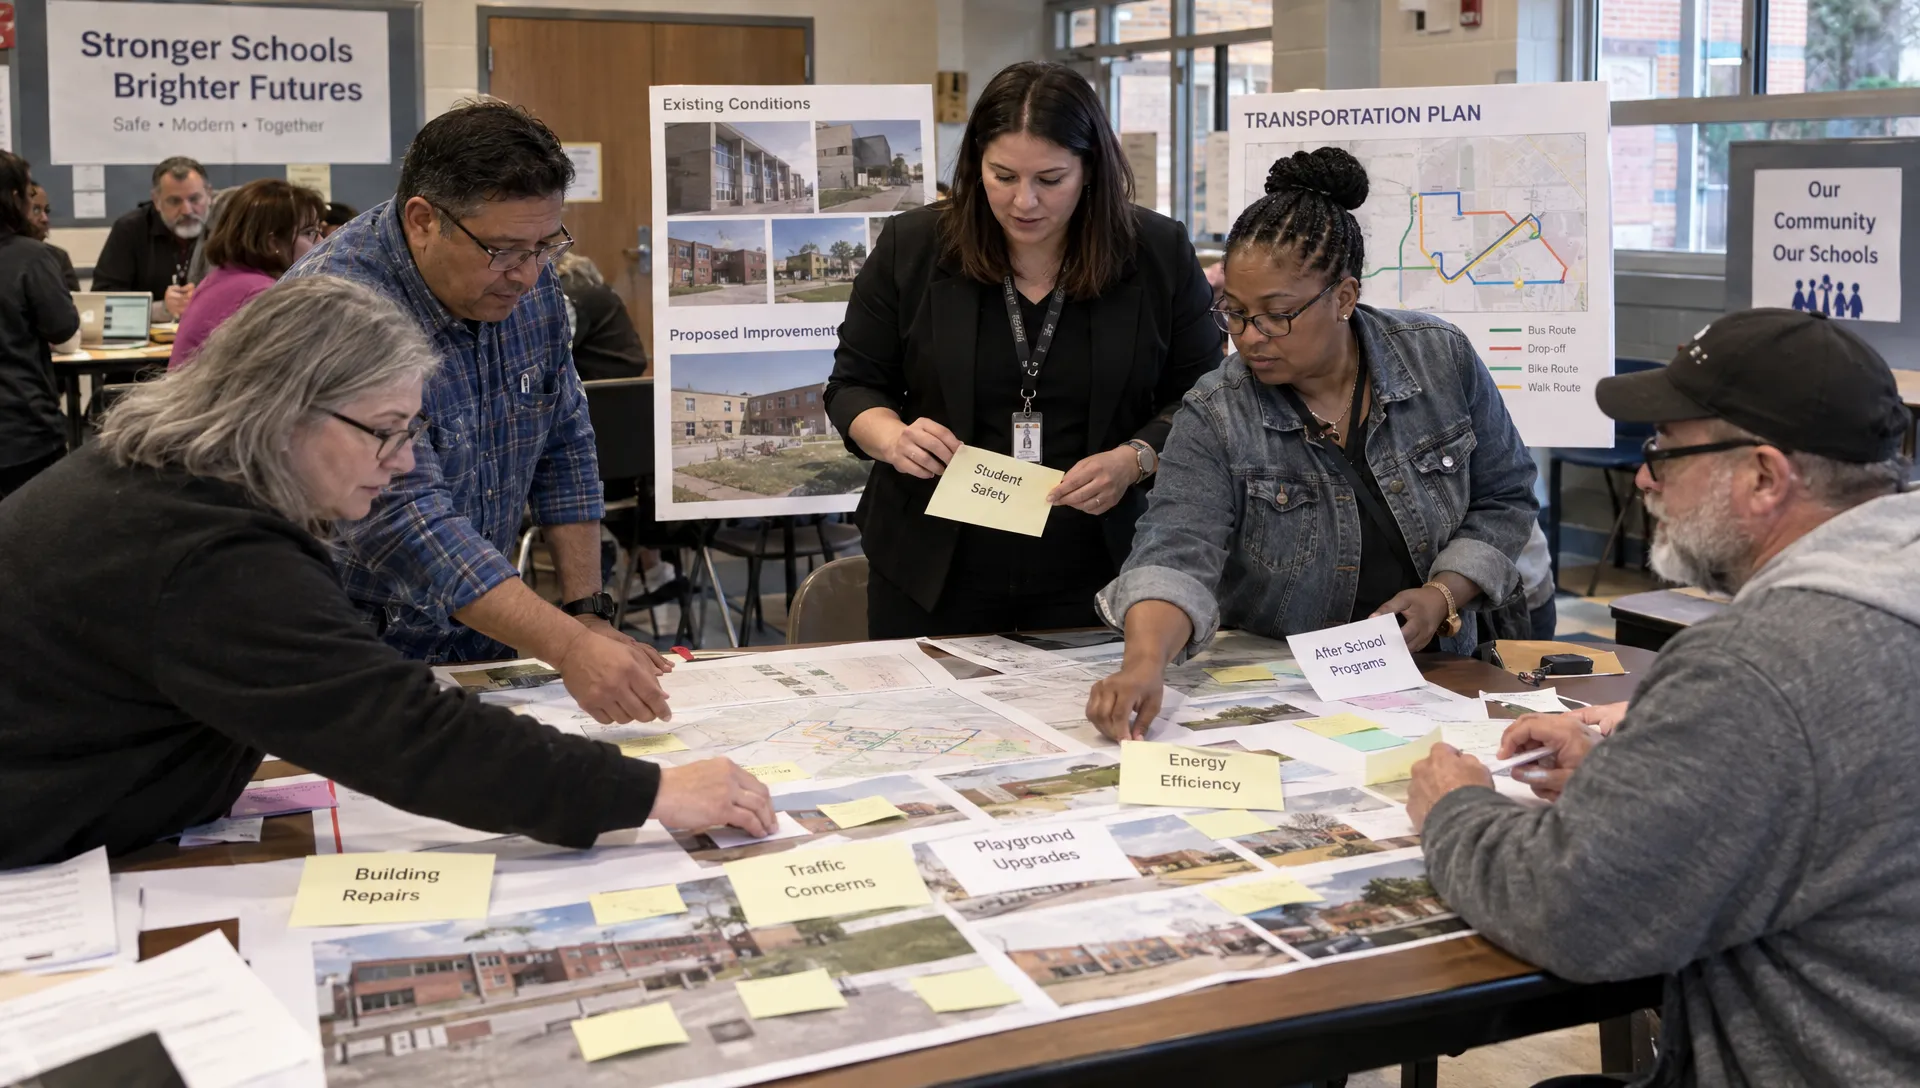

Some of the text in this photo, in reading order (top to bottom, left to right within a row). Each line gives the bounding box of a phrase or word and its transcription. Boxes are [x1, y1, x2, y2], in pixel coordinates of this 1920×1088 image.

[82, 31, 352, 65] Stronger Schools
[114, 73, 362, 105] Brighter Futures
[664, 98, 810, 113] Existing Conditions
[113, 116, 324, 136] Safe Modern Together
[1244, 105, 1480, 128] TRANSPORTATION PLAN
[1809, 181, 1840, 198] Our
[1774, 212, 1876, 234] Community
[1773, 244, 1878, 264] Our Schools
[670, 327, 738, 343] Proposed
[1528, 324, 1577, 335] Bus Route
[1528, 344, 1566, 355] Drop-off
[1528, 363, 1579, 374] Bike Route
[1528, 382, 1581, 393] Walk Route
[974, 463, 1023, 487] Student
[971, 482, 1010, 504] Safety
[1315, 634, 1386, 661] After School
[1329, 656, 1387, 677] Programs
[1169, 752, 1227, 772] Energy
[1160, 774, 1241, 794] Efficiency
[973, 828, 1075, 854] Playground
[785, 859, 846, 877] Traffic
[992, 848, 1081, 872] Upgrades
[356, 868, 439, 883] Building
[343, 889, 419, 904] Repairs
[784, 875, 877, 899] Concerns
